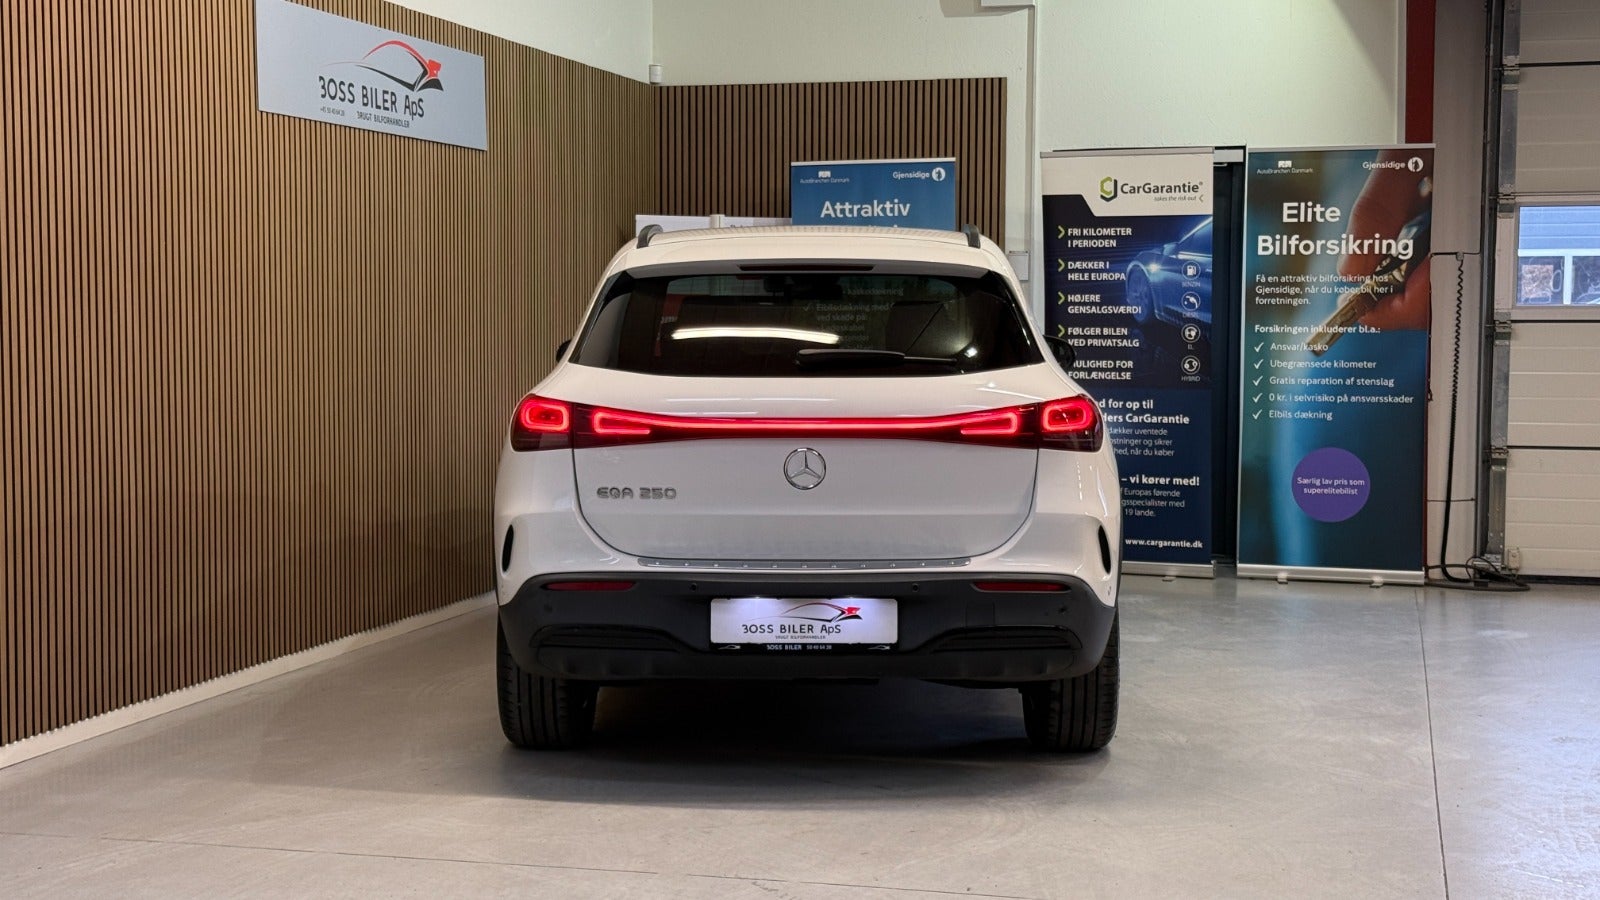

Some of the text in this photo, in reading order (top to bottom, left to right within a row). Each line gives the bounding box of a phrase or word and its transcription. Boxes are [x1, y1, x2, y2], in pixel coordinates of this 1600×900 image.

[361, 85, 397, 113] BILER
[404, 94, 424, 120] ApS
[1362, 161, 1406, 170] Gjensidige
[893, 171, 930, 180] Gjensidige
[1120, 182, 1199, 194] CarGarantie
[820, 199, 910, 218] Attraktiv
[1282, 201, 1341, 223] Elite
[1068, 228, 1132, 236] FRI KILOMETER
[1068, 239, 1116, 248] I PERIODEN
[1257, 233, 1414, 260] Bilforsikring
[1068, 261, 1105, 269] DÆKKER
[1068, 273, 1126, 281] HELE EUROPA
[1256, 274, 1266, 283] Få
[1280, 274, 1317, 283] attraktiv
[1319, 274, 1370, 285] bilforsikring
[1373, 275, 1388, 283] hos
[1256, 286, 1393, 295] Gjensidige, når du køber bil her i
[1068, 294, 1100, 302] HØJERE
[1255, 297, 1311, 306] forretningen.
[1068, 306, 1141, 314] GENSALGSVÆRDI
[1068, 327, 1101, 335] FØLGER
[1255, 324, 1381, 334] Forsikringen inkluderer bl.a.:
[1068, 339, 1140, 347] VED PRIVATSALG
[1269, 343, 1329, 351] Ansvar/kasko
[1270, 360, 1377, 370] Ubegrænsede kilometer
[1068, 371, 1131, 380] FORLÆNGELSE
[1269, 376, 1295, 385] Gratis
[1297, 377, 1344, 387] reparation
[1357, 378, 1395, 387] stenslag
[1276, 393, 1287, 401] kr.
[1294, 394, 1334, 402] selvrisiko
[1337, 394, 1348, 404] på
[1350, 395, 1414, 404] ansvarsskader
[1108, 399, 1123, 408] for
[1126, 401, 1140, 410] op
[1143, 399, 1154, 409] til
[1125, 414, 1190, 424] CarGarantie
[1269, 410, 1333, 421] Elbils dækning
[1154, 448, 1174, 456] køber
[1130, 474, 1139, 484] vi
[1142, 474, 1170, 484] kører
[1172, 476, 1200, 486] med!
[1297, 477, 1320, 486] Særlig
[1334, 478, 1348, 486] pris
[597, 487, 677, 499] EQA 250
[1124, 488, 1151, 496] Europas
[1153, 488, 1180, 497] førende
[1304, 487, 1358, 495] superelitebilist
[1125, 539, 1203, 548] www.cargarantie.dk
[780, 624, 814, 634] BILER
[820, 624, 841, 635] ApS
